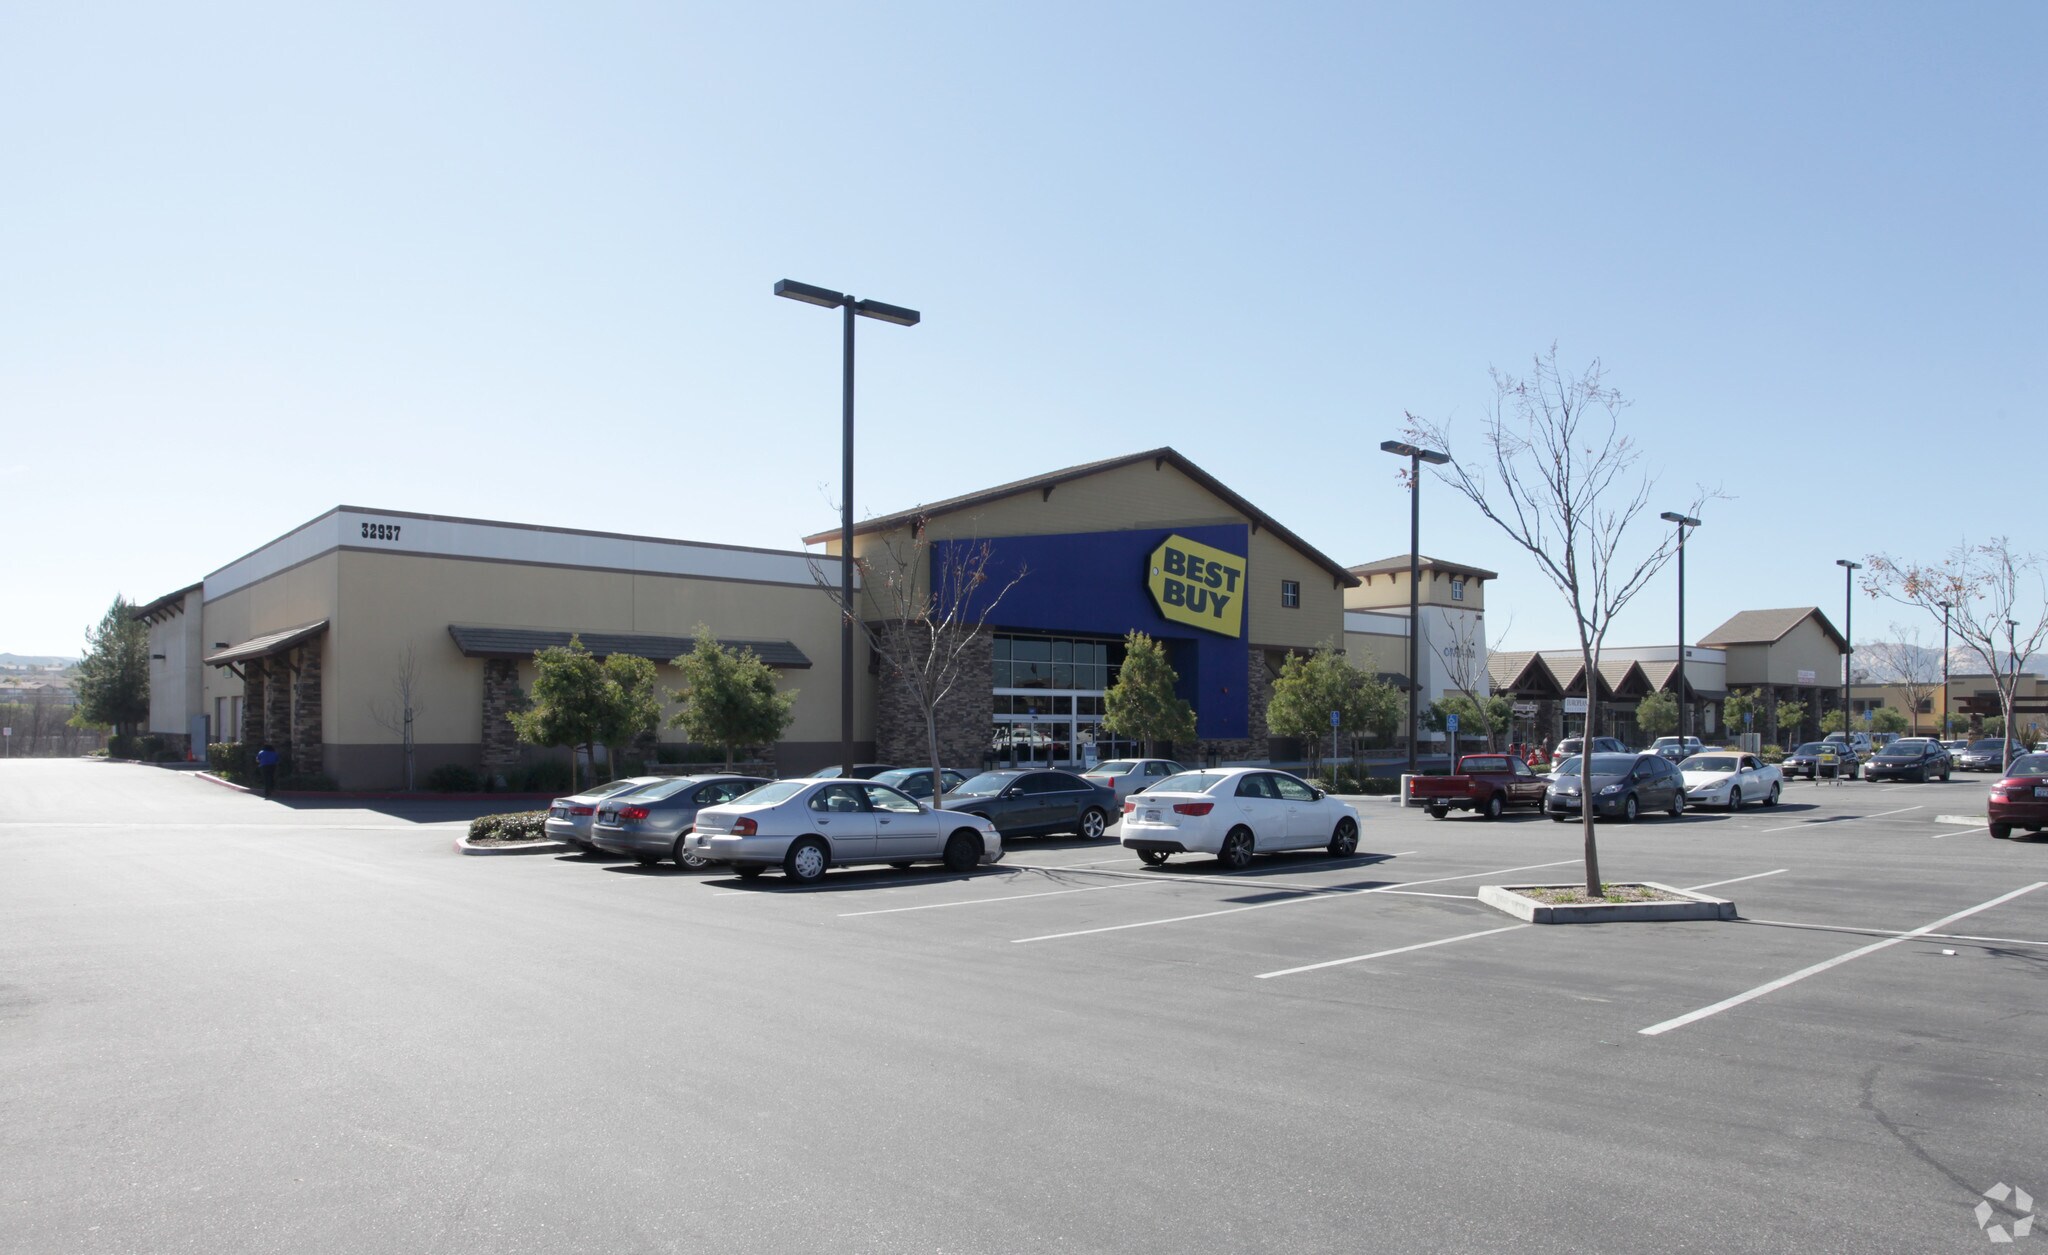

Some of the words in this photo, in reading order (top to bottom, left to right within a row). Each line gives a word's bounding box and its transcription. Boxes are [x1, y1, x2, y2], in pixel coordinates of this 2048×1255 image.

[361, 522, 401, 541] 32937
[1163, 546, 1241, 593] BEST
[1163, 577, 1231, 618] BUY
